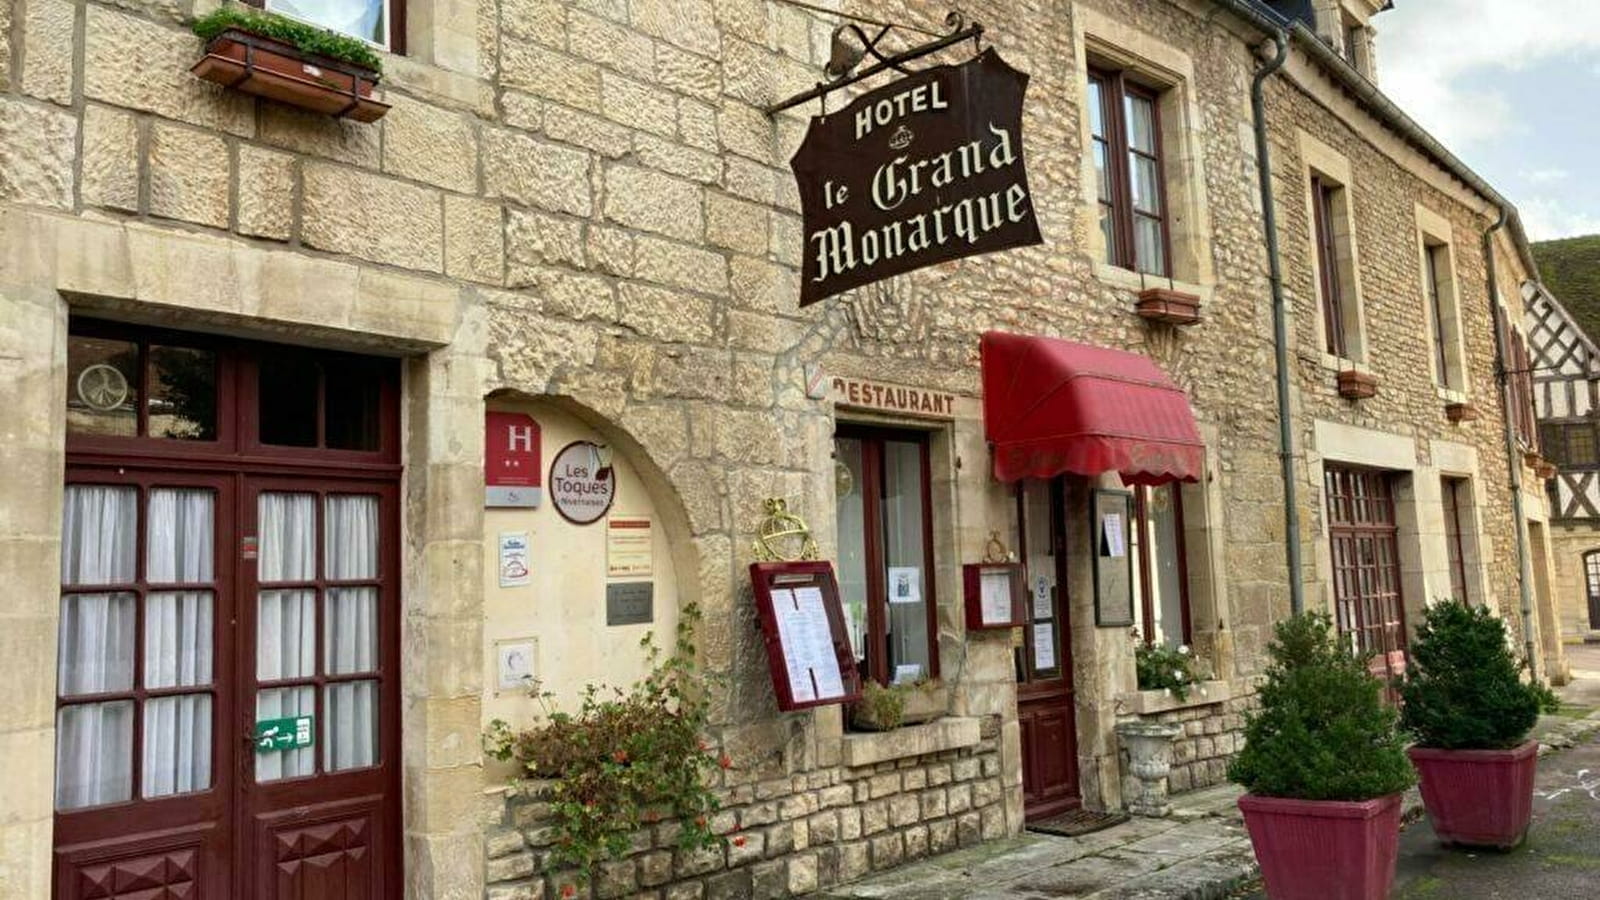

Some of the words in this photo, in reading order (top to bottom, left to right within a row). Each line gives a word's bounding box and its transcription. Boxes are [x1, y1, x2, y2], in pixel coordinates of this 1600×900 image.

[855, 82, 947, 139] HOTEL
[824, 181, 848, 209] le
[872, 121, 1016, 211] Grand
[811, 183, 1026, 282] Monarque
[509, 425, 532, 452] H
[555, 477, 608, 496] Toques
[566, 464, 588, 478] Les
